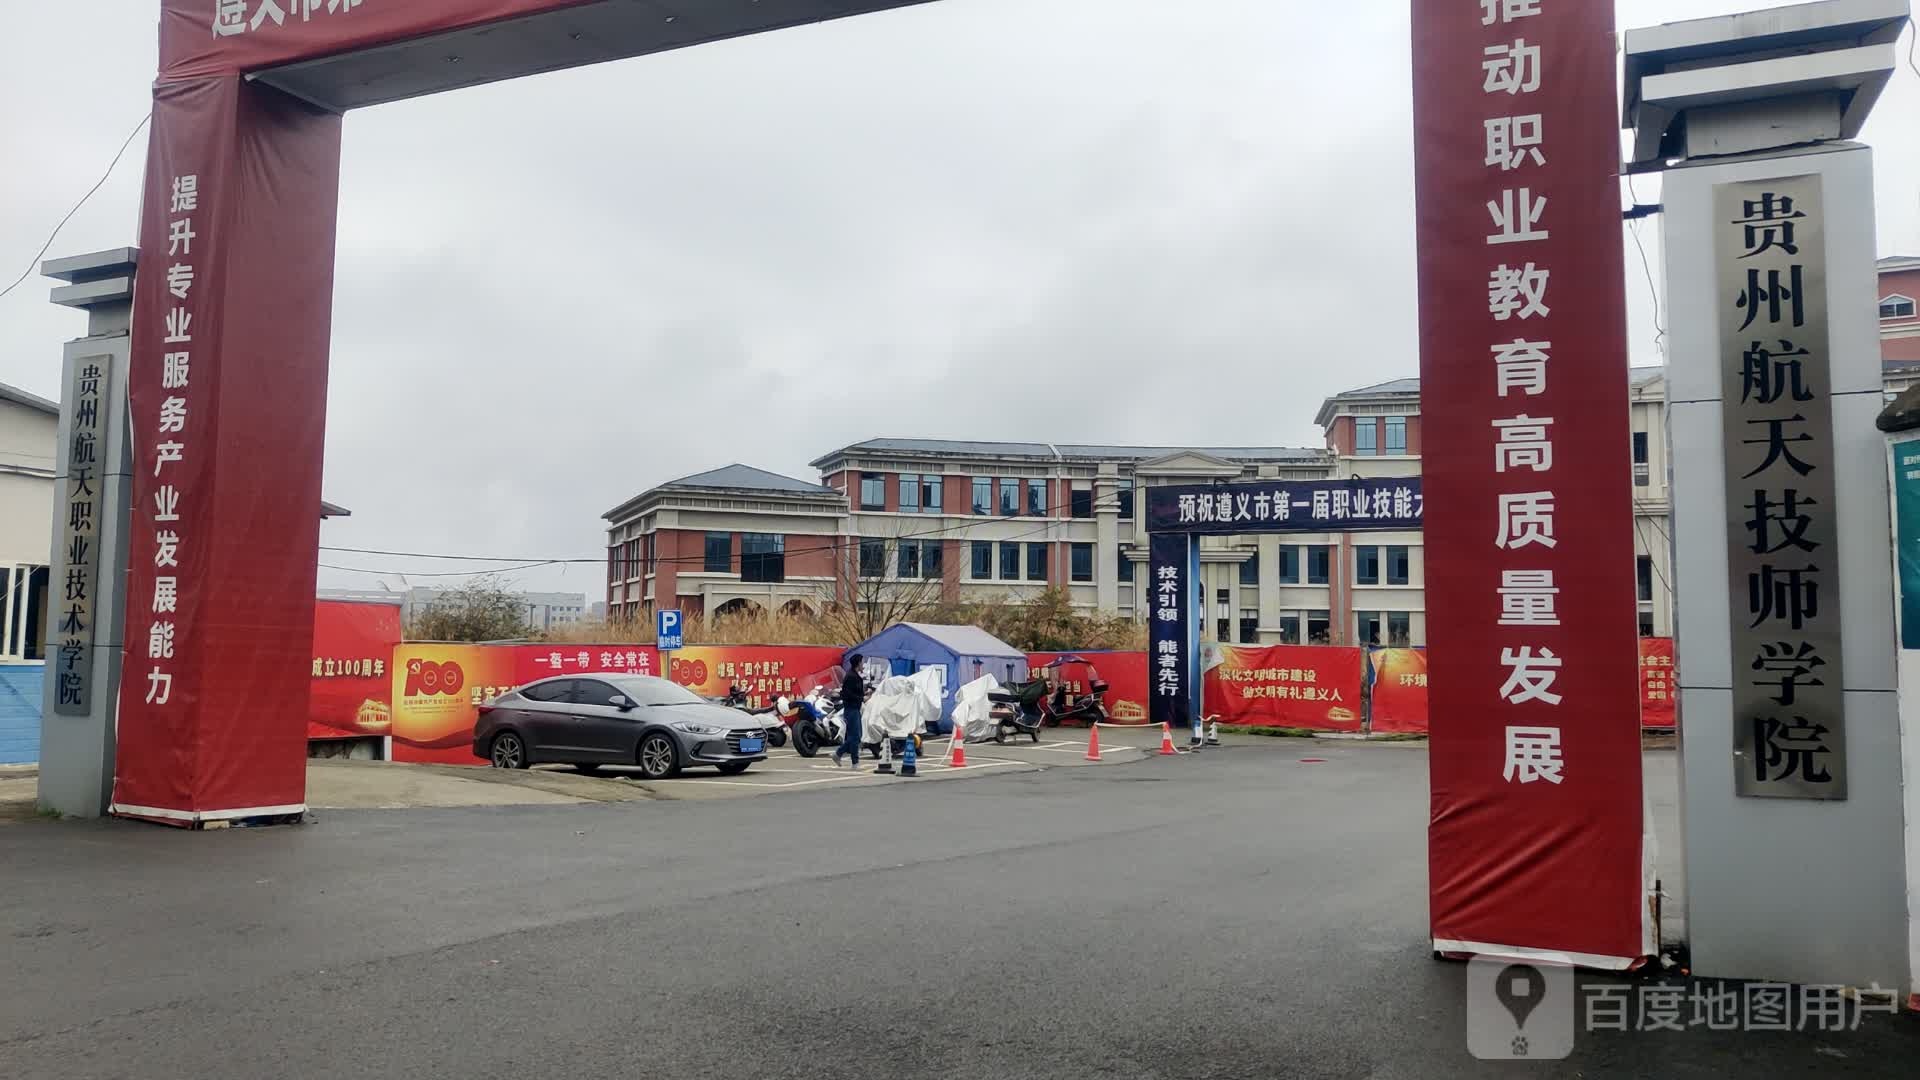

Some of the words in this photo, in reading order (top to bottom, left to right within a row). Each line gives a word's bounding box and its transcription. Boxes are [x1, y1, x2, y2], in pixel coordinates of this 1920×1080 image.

[145, 175, 198, 706] 提升专业服务产业发展能力
[1731, 193, 1833, 784] 贵州航天技师学院
[59, 364, 103, 706] 贵州航天职业技术学院
[1157, 566, 1179, 622] 技术引领
[662, 612, 678, 635] P
[312, 657, 385, 677] 成立100周年
[534, 652, 590, 669] 一盔一带
[601, 651, 650, 667] 安全常在
[1158, 639, 1179, 696] 能者先行
[1219, 667, 1317, 683] 深化文明城市建设
[1399, 673, 1428, 688] 环境
